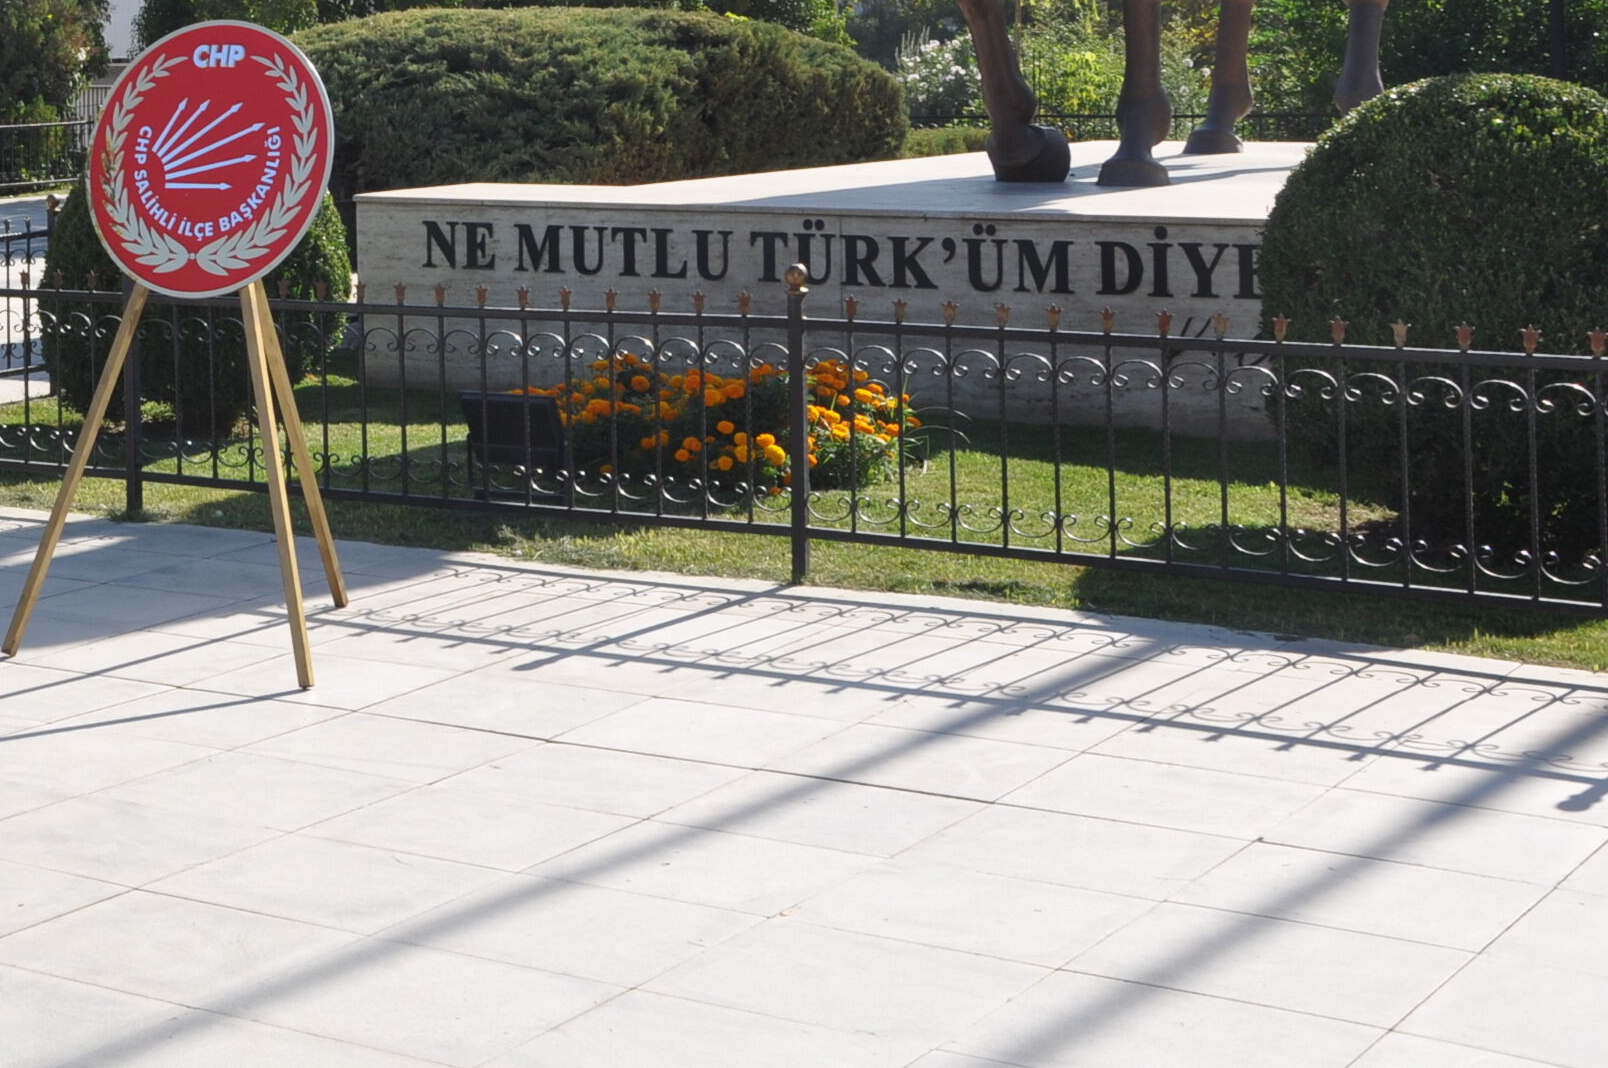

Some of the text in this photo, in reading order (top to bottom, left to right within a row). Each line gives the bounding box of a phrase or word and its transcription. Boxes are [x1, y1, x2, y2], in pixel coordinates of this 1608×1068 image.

[193, 44, 246, 68] CHP
[134, 125, 282, 241] CHP SALİHLİ İLÇE BAŞKANLIĞI
[422, 220, 496, 270] NE
[513, 223, 734, 281] MUTLU
[750, 219, 1075, 294] TÜRK'ÜM
